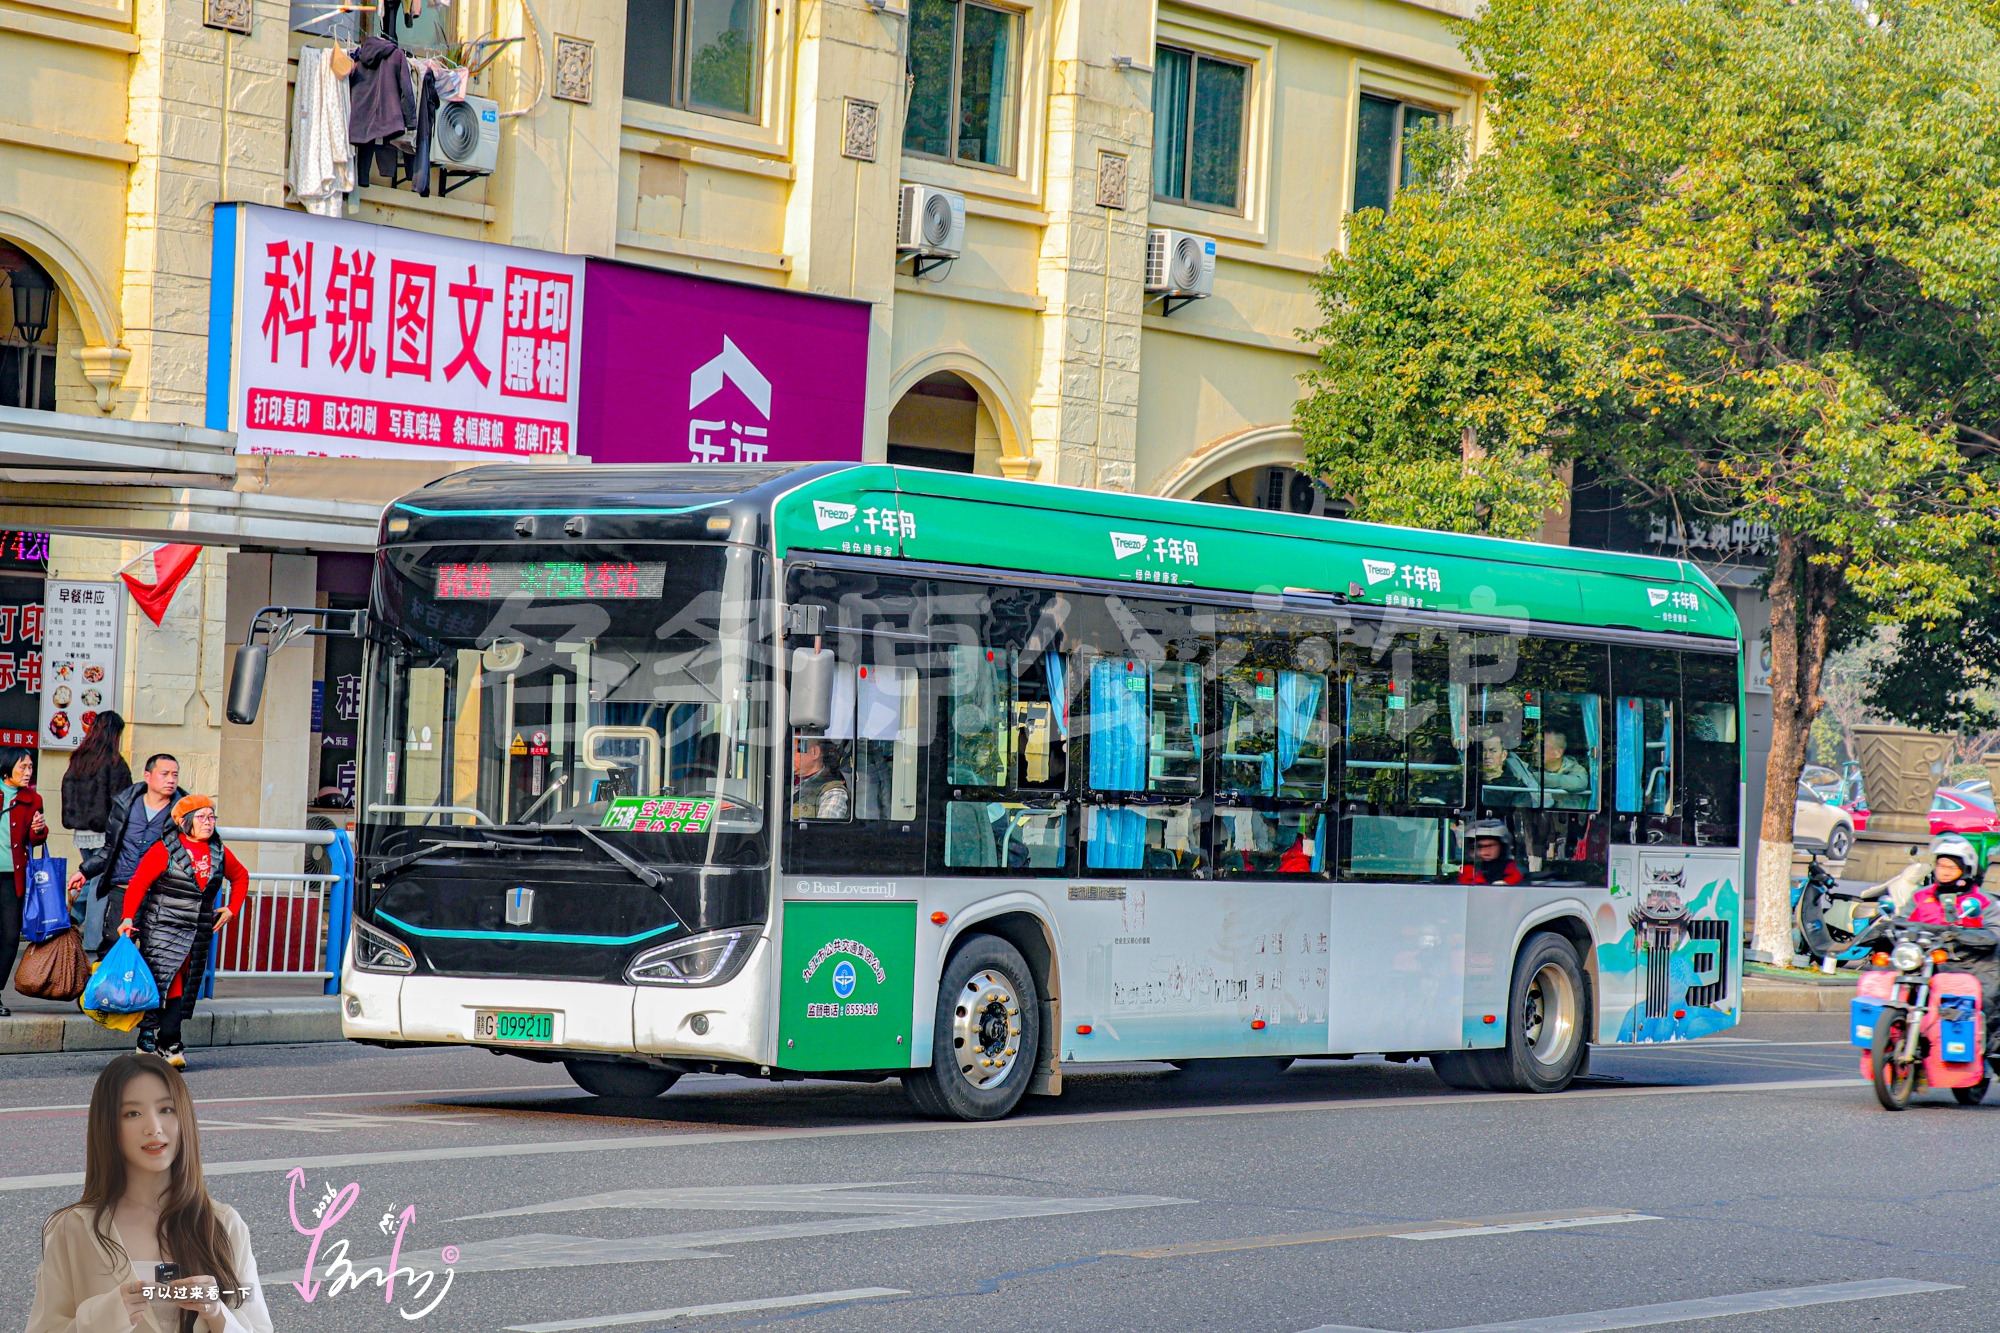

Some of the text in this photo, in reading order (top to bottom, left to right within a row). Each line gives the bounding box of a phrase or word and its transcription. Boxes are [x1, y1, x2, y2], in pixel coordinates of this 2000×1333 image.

[262, 240, 493, 388] 科锐图文
[508, 274, 568, 334] 打印
[504, 336, 566, 395] 照相
[254, 394, 563, 454] 打印复印 图文印刷 写真喷绘 条幅旗帜 招牌门头
[819, 507, 916, 539] Treezo 千年舟
[842, 541, 892, 557] 绿色健康家
[1115, 537, 1199, 567] Treezo 千年舟
[1367, 564, 1441, 593] Treezo 千年舟
[59, 588, 105, 604] 早餐供应
[1671, 591, 1699, 611] 千年舟
[639, 800, 711, 820] 空调开启
[802, 938, 886, 984] 九江市公共交通集团公司
